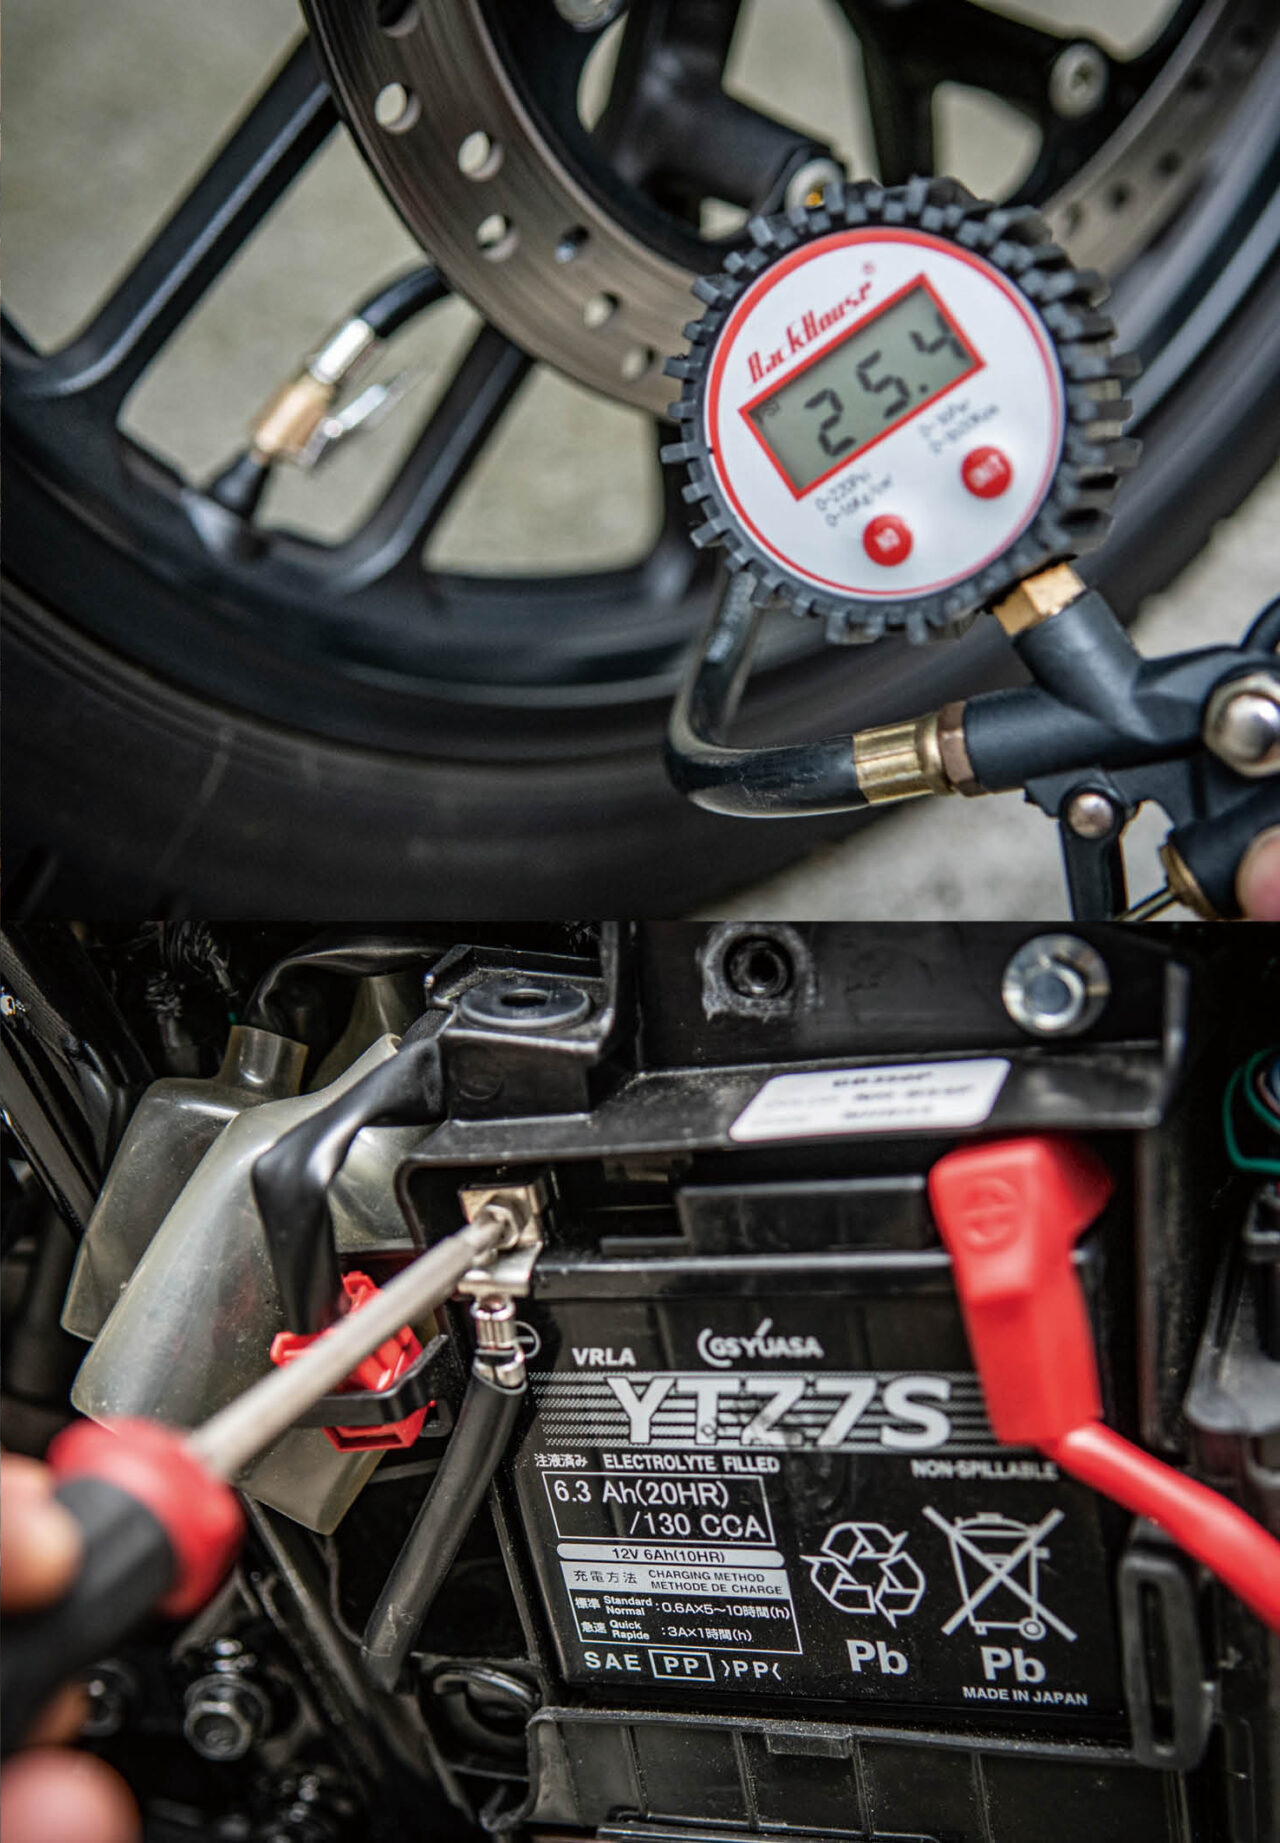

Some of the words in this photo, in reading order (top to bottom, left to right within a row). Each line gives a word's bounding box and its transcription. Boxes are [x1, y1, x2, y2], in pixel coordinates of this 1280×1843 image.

[572, 1347, 637, 1367] VRLA
[605, 1376, 953, 1451] YTZ7S
[534, 1453, 589, 1469] 注液済み
[602, 1454, 718, 1472] ELECTROLYTE
[722, 1456, 781, 1474] FILLED
[553, 1479, 592, 1503] 6.3
[601, 1478, 729, 1509] Ah(20HR)
[629, 1511, 692, 1536] /130
[700, 1513, 767, 1539] CCA
[611, 1549, 639, 1561] 12V
[643, 1549, 726, 1564] 6Ah(10HR)
[573, 1570, 638, 1585] 充電方法
[648, 1569, 712, 1581] CHARGING
[713, 1572, 766, 1583] METHOD
[650, 1581, 709, 1592] METHODE
[711, 1583, 728, 1593] DE
[731, 1584, 783, 1595] CHARGE
[603, 1596, 653, 1607] Standard
[605, 1606, 646, 1617] Normal
[609, 1620, 642, 1631] Quick
[612, 1630, 651, 1641] Rapide
[583, 1652, 642, 1672] SAE
[663, 1656, 700, 1675] PP
[846, 1639, 909, 1676] Pb
[980, 1646, 1047, 1684] Pb
[962, 1686, 1010, 1701] MADE
[1011, 1689, 1030, 1702] IN
[1031, 1691, 1089, 1706] JAPAN
